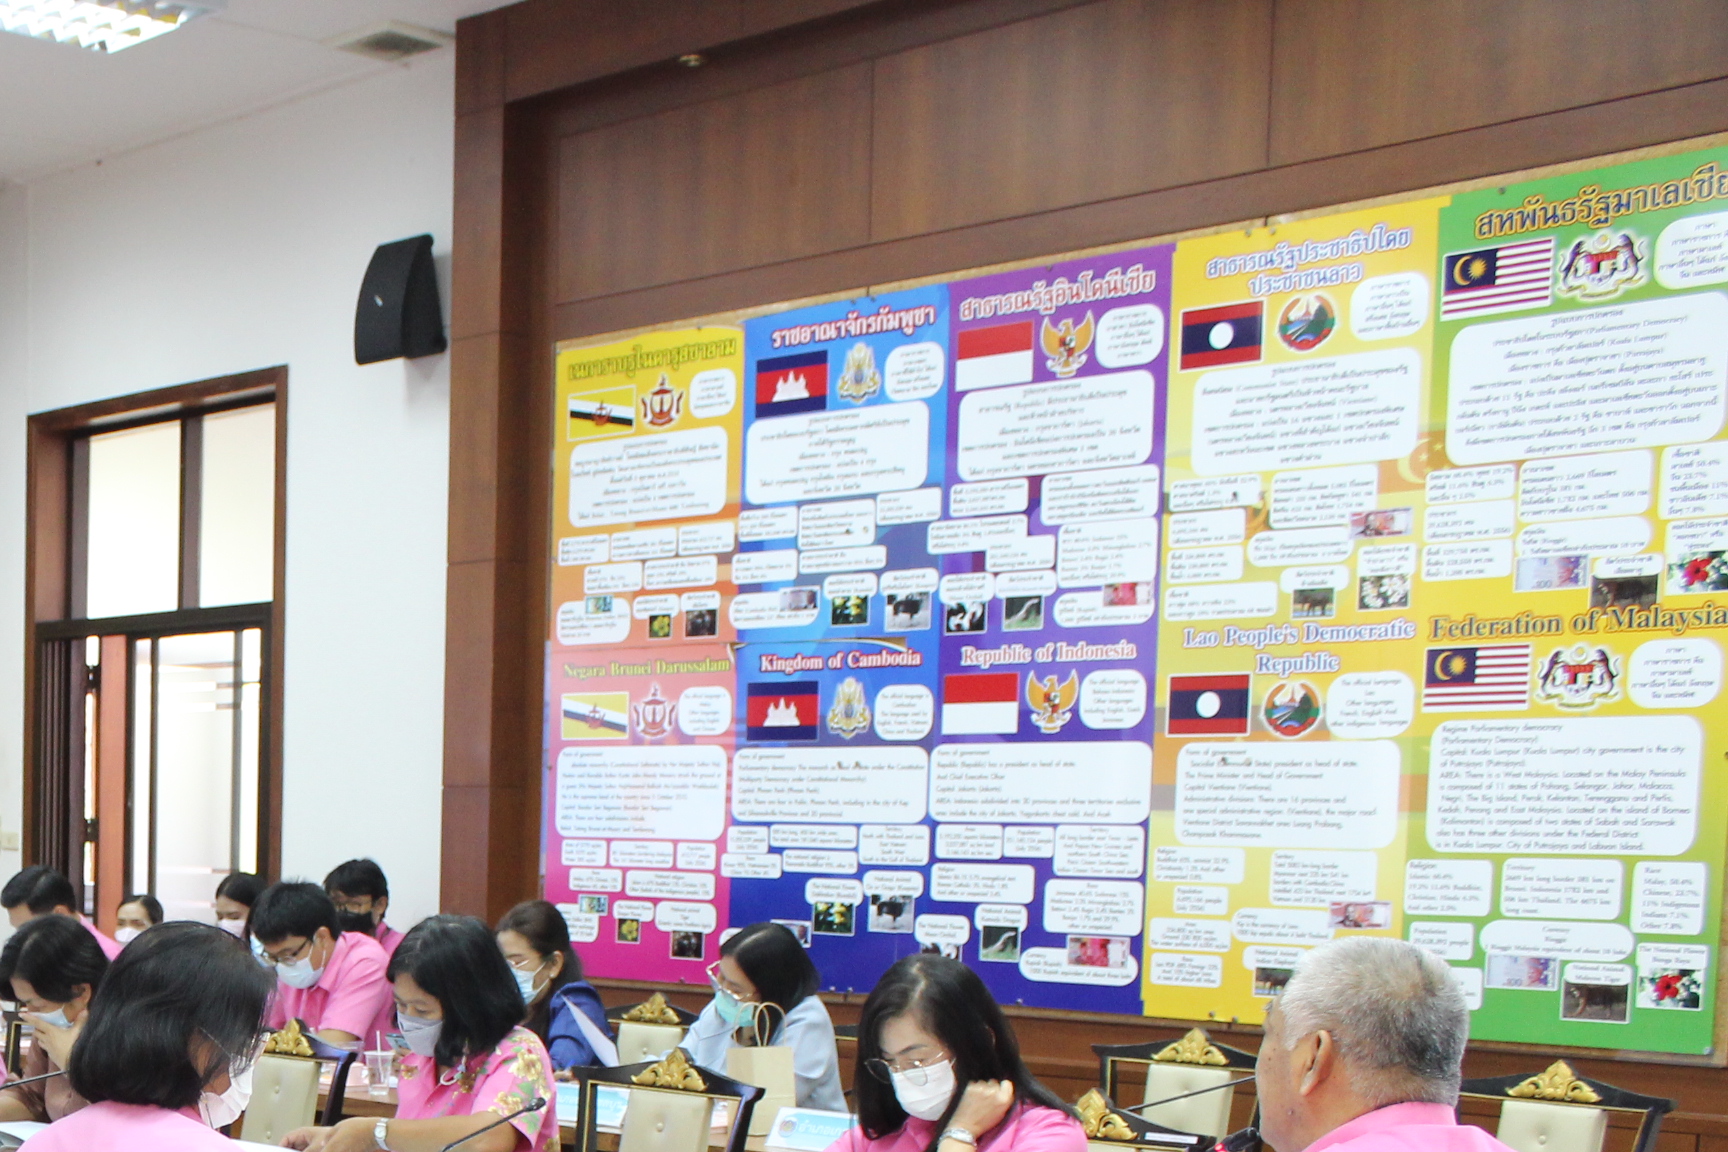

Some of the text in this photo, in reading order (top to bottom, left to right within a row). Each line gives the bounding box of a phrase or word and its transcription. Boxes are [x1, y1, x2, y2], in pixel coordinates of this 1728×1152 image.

[1207, 224, 1411, 277] สาธารณรัฐประชาธิปไตย
[960, 264, 1156, 319] สาธารณรัฐอินโดนีเซีย
[1249, 263, 1362, 296] ประชาชนลาว
[772, 306, 935, 347] ราชอาณาจักรกัมพูชา
[1184, 619, 1415, 648] Lao People's Democratic
[1430, 603, 1728, 640] Federation of Malaysia
[564, 657, 730, 679] Negara Brunei Darussalam
[761, 649, 921, 674] Kingdom of Cambodia
[962, 639, 1136, 669] Republic of Indonesia
[1257, 653, 1340, 677] Republic
